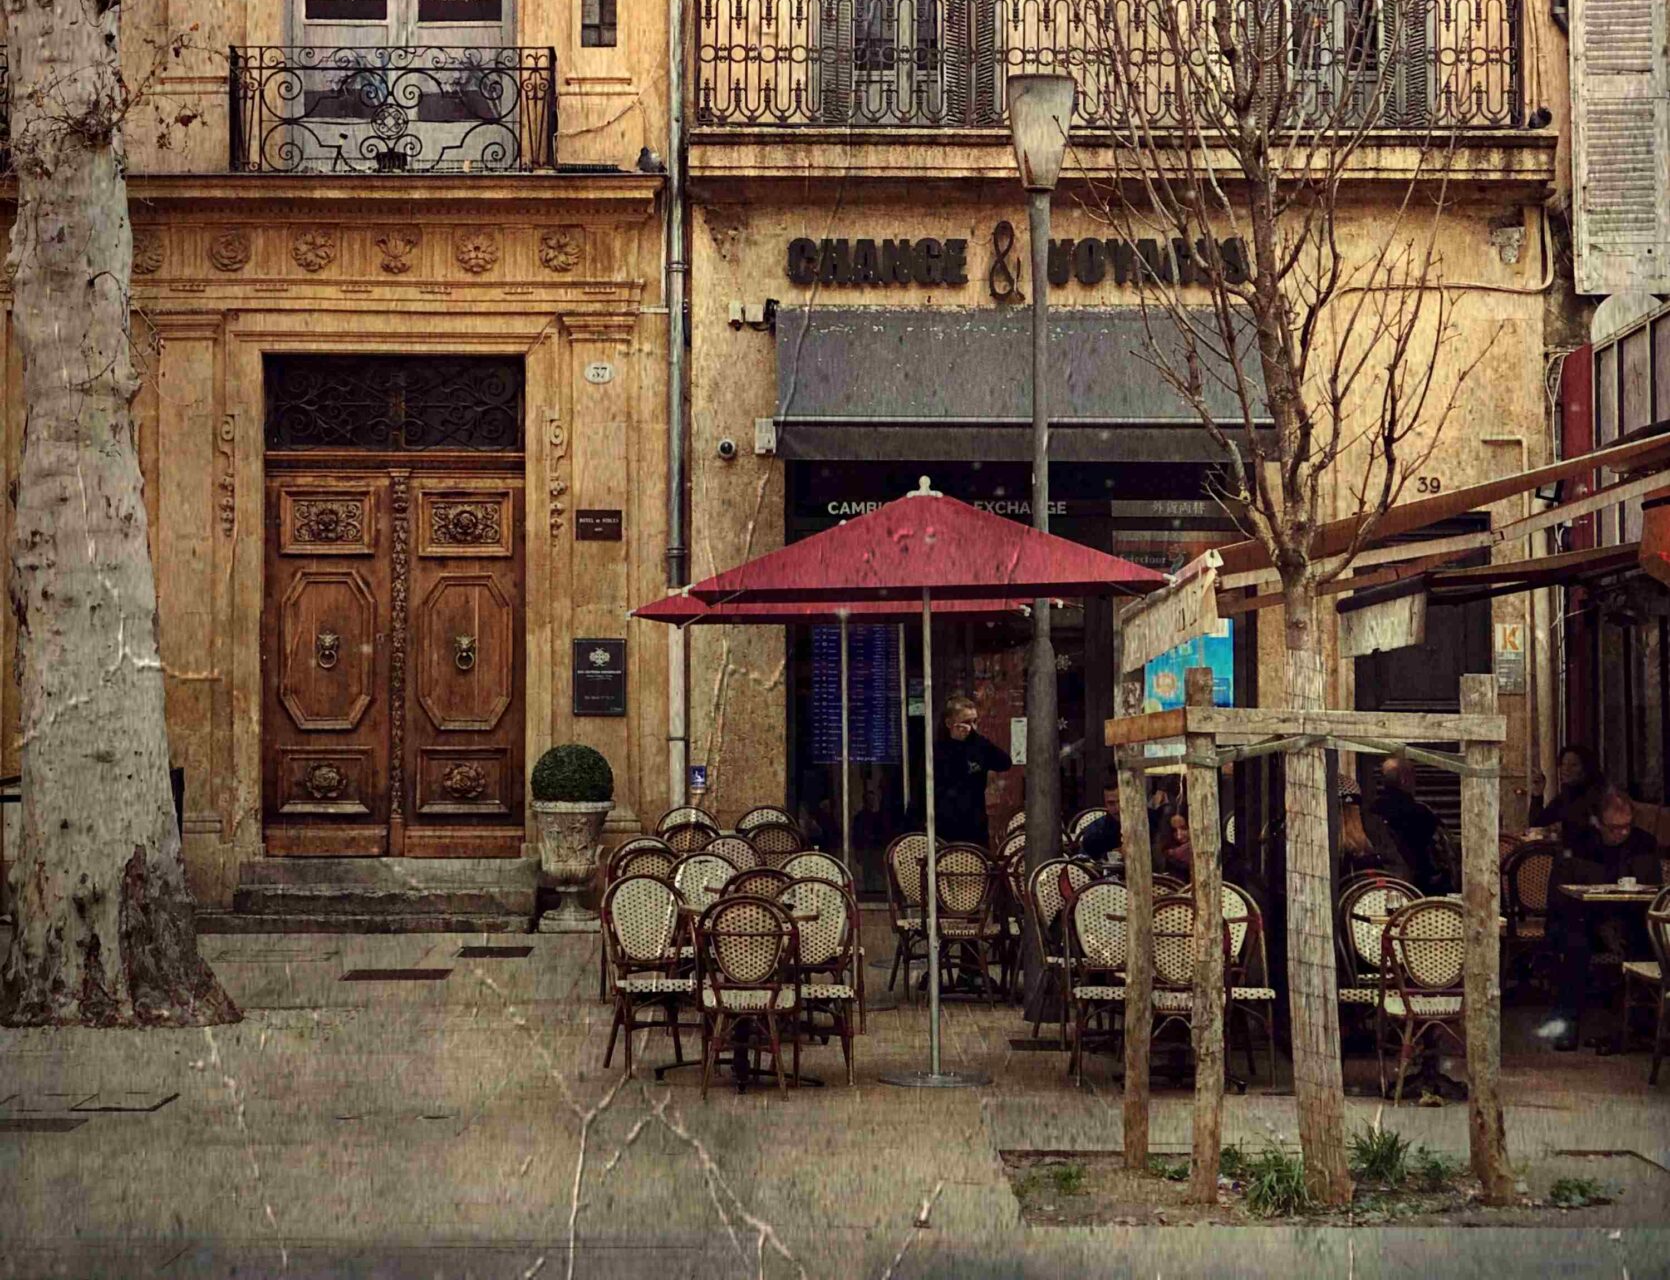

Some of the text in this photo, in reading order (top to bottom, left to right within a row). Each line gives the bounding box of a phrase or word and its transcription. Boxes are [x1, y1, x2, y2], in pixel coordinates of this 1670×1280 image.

[788, 237, 969, 285] CHANGE
[989, 220, 1026, 303] &
[592, 366, 608, 379] 37
[1416, 476, 1441, 494] 39
[828, 501, 1067, 515] CAMBI EXCHAGE
[1501, 626, 1520, 651] K
